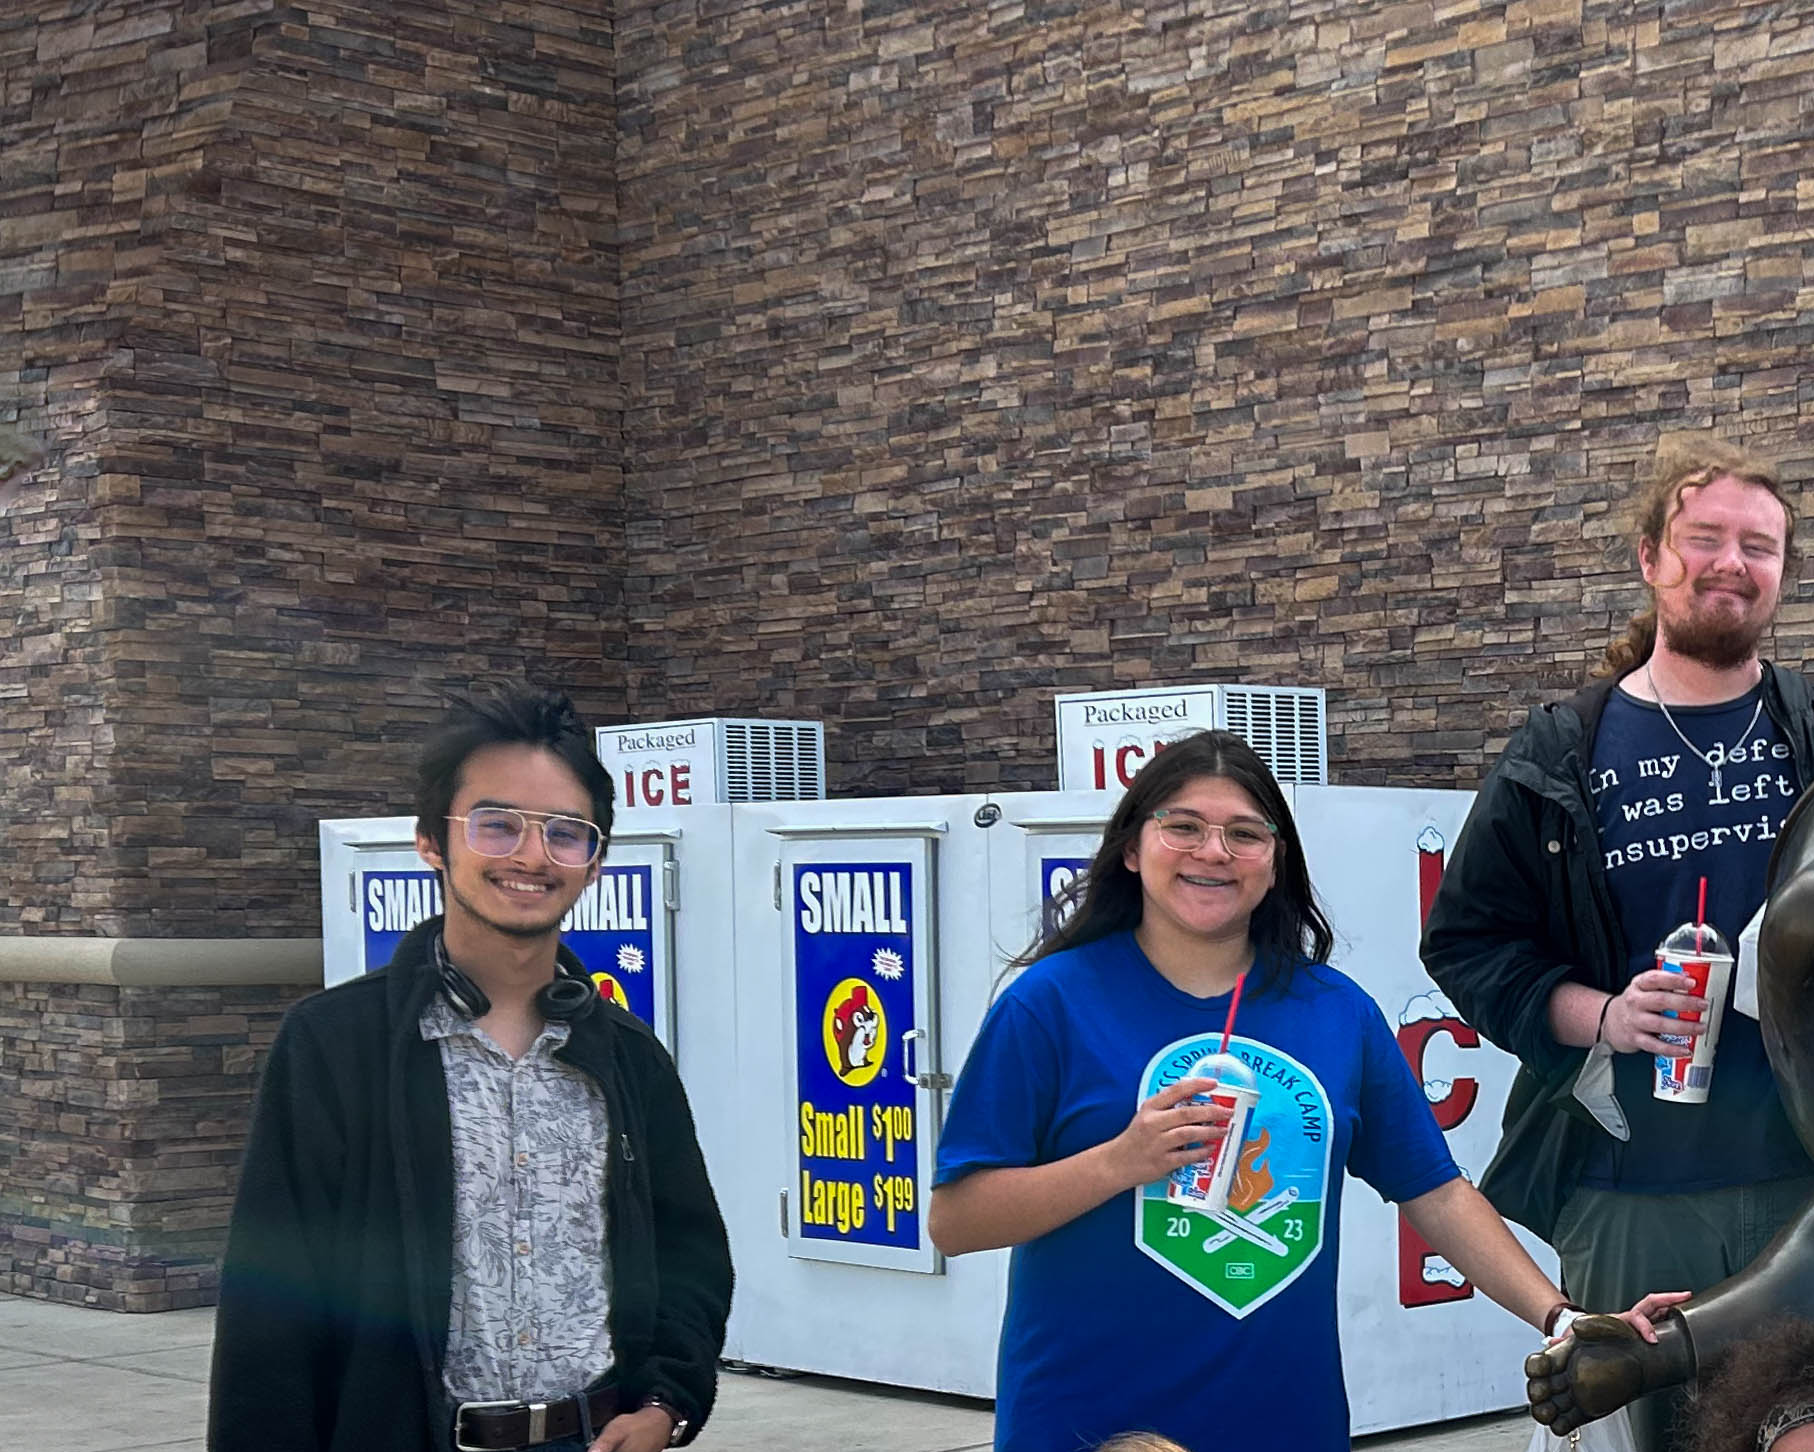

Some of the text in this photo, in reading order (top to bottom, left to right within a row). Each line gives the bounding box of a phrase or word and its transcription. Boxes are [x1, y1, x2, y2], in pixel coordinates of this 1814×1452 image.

[1084, 699, 1188, 724] Packaged
[617, 728, 696, 751] Packaged
[1092, 738, 1168, 790] IC
[624, 760, 692, 807] ICE
[1637, 754, 1680, 779] my
[1621, 793, 1684, 821] was
[1708, 774, 1794, 805] left
[1605, 815, 1786, 870] nsupervi
[367, 878, 443, 932] SMAL
[800, 871, 907, 934] SMALL
[1241, 1051, 1300, 1091] BREAK
[1295, 1091, 1321, 1143] CAMP
[800, 1101, 864, 1160] Small
[802, 1169, 865, 1234] Large
[1166, 1217, 1303, 1241] 20 23
